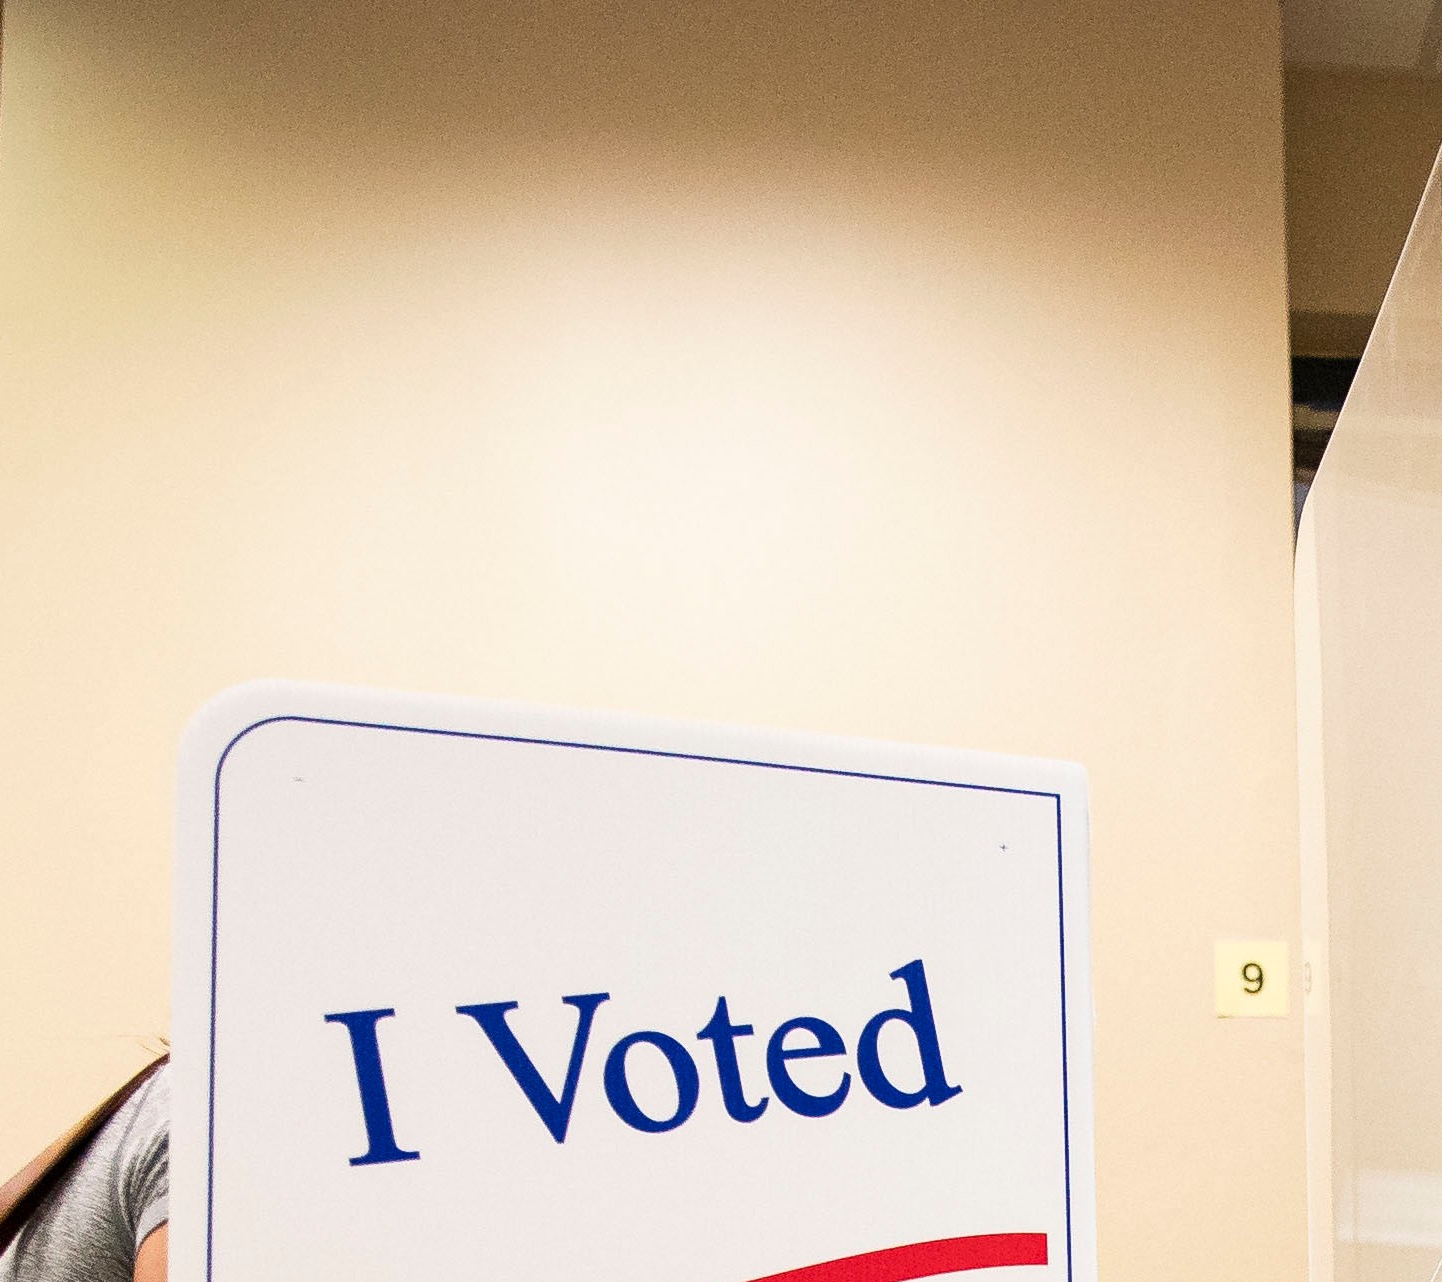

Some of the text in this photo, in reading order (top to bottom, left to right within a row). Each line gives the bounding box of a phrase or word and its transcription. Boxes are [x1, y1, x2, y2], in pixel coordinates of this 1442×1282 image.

[1241, 961, 1265, 995] 9
[324, 959, 964, 1167] I Voted
